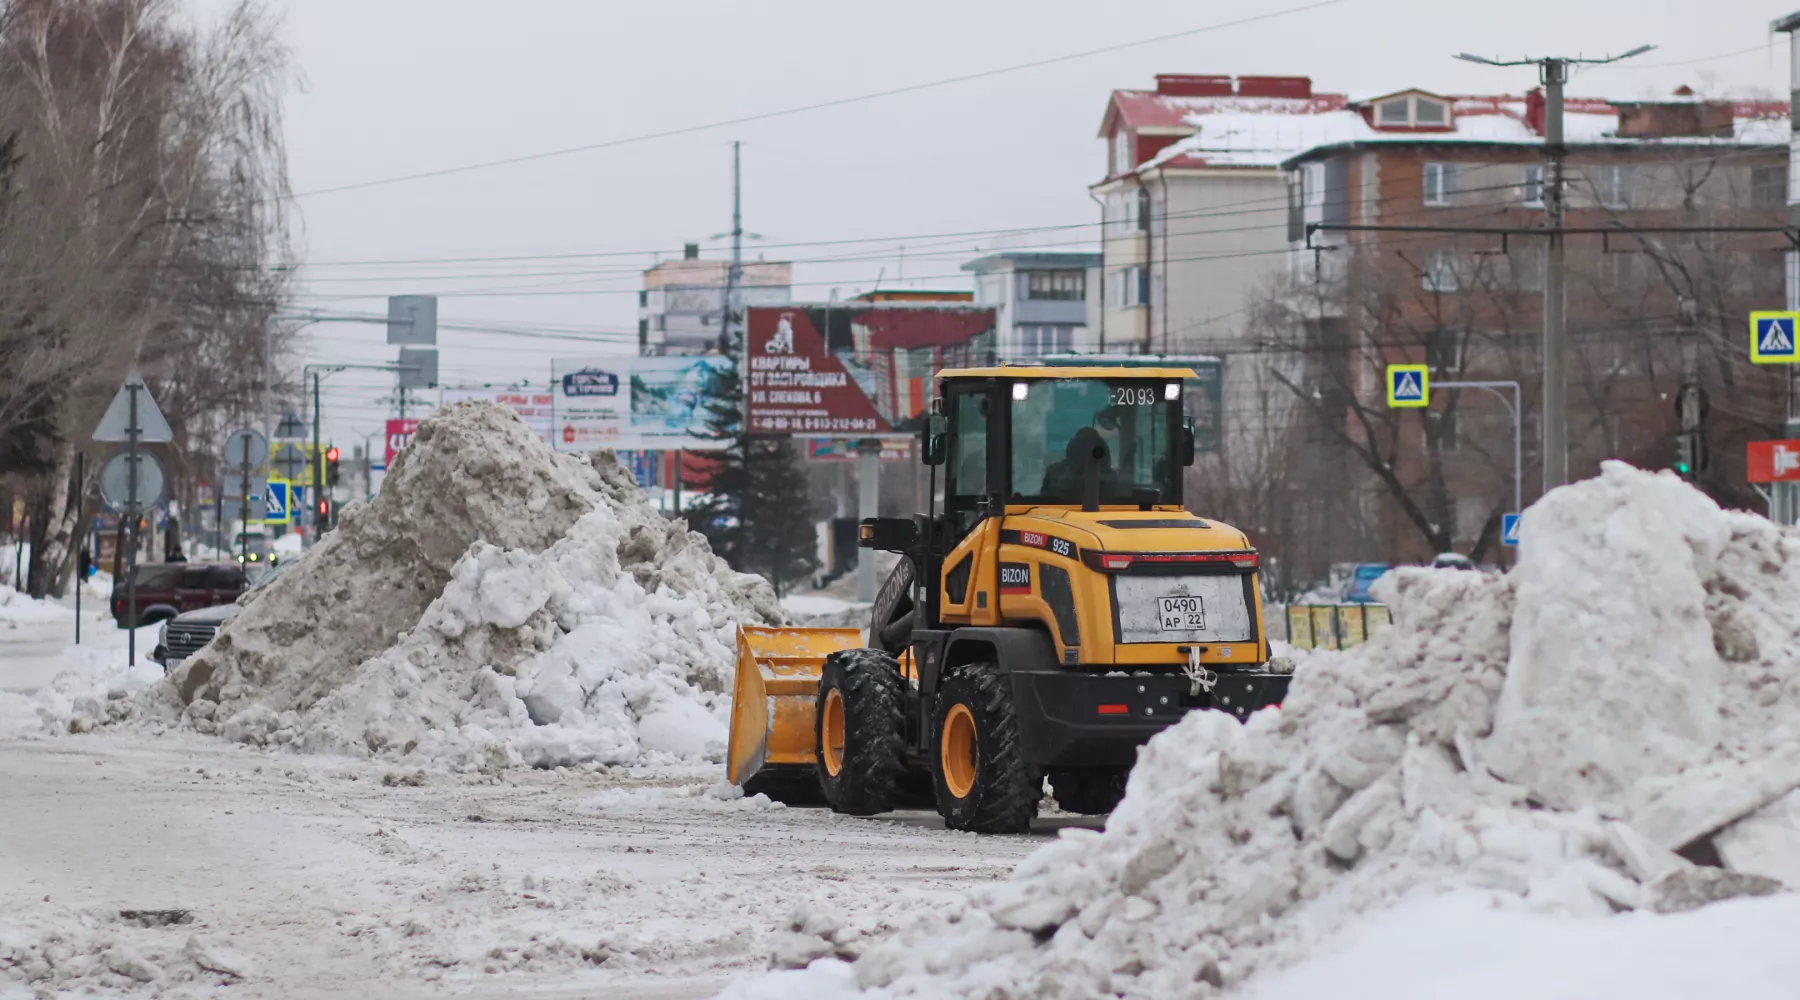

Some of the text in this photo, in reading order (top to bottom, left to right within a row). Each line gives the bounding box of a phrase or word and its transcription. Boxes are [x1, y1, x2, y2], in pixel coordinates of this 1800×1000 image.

[751, 356, 810, 370] КВАРТИРЫ
[767, 372, 847, 387] ЗАСТРОЙЩИКА
[1024, 532, 1070, 556] BIZON 925
[1001, 568, 1029, 584] BIZON
[1164, 598, 1197, 612] 0490
[1165, 614, 1202, 628] АР 22
